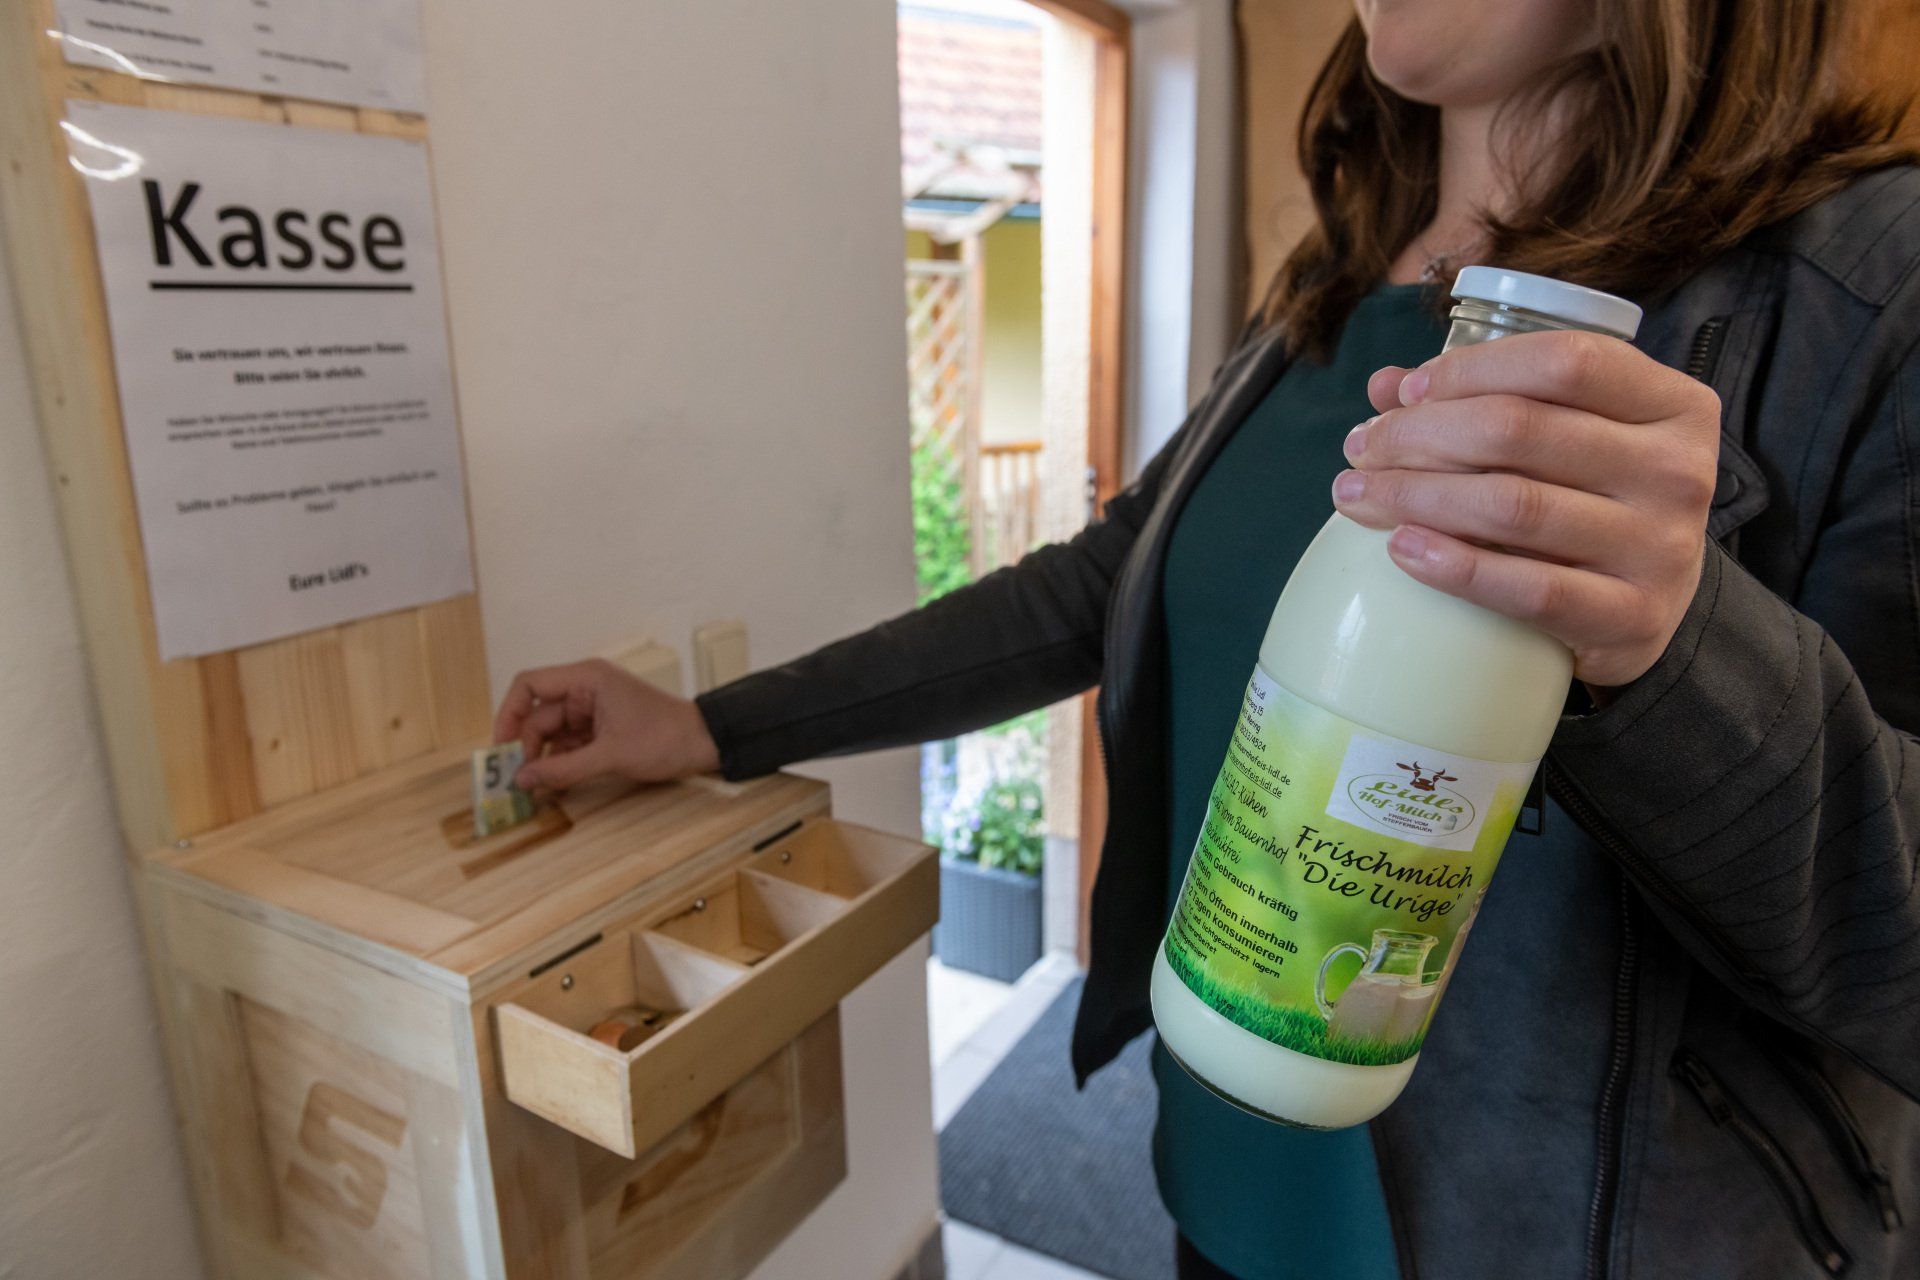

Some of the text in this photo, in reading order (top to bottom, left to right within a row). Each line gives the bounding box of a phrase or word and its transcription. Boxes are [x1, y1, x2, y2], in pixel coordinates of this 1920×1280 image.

[142, 179, 406, 273] Kasse
[288, 562, 370, 592] Eure Lidl's
[484, 754, 500, 790] 5
[1358, 790, 1443, 822] Hof-Milch
[1233, 815, 1289, 865] Bauernhof
[1296, 825, 1473, 889] Frischmilch
[1213, 857, 1255, 897] Gebrauch
[1257, 890, 1298, 922] kräftig
[1298, 851, 1365, 898] "Die
[1192, 890, 1212, 919] Tagen
[1212, 912, 1284, 966] konsumieren
[1202, 921, 1250, 962] lichtgeschützt
[1252, 958, 1281, 979] lagern
[1208, 889, 1239, 922] Öffnen
[1240, 915, 1298, 955] innerhalb
